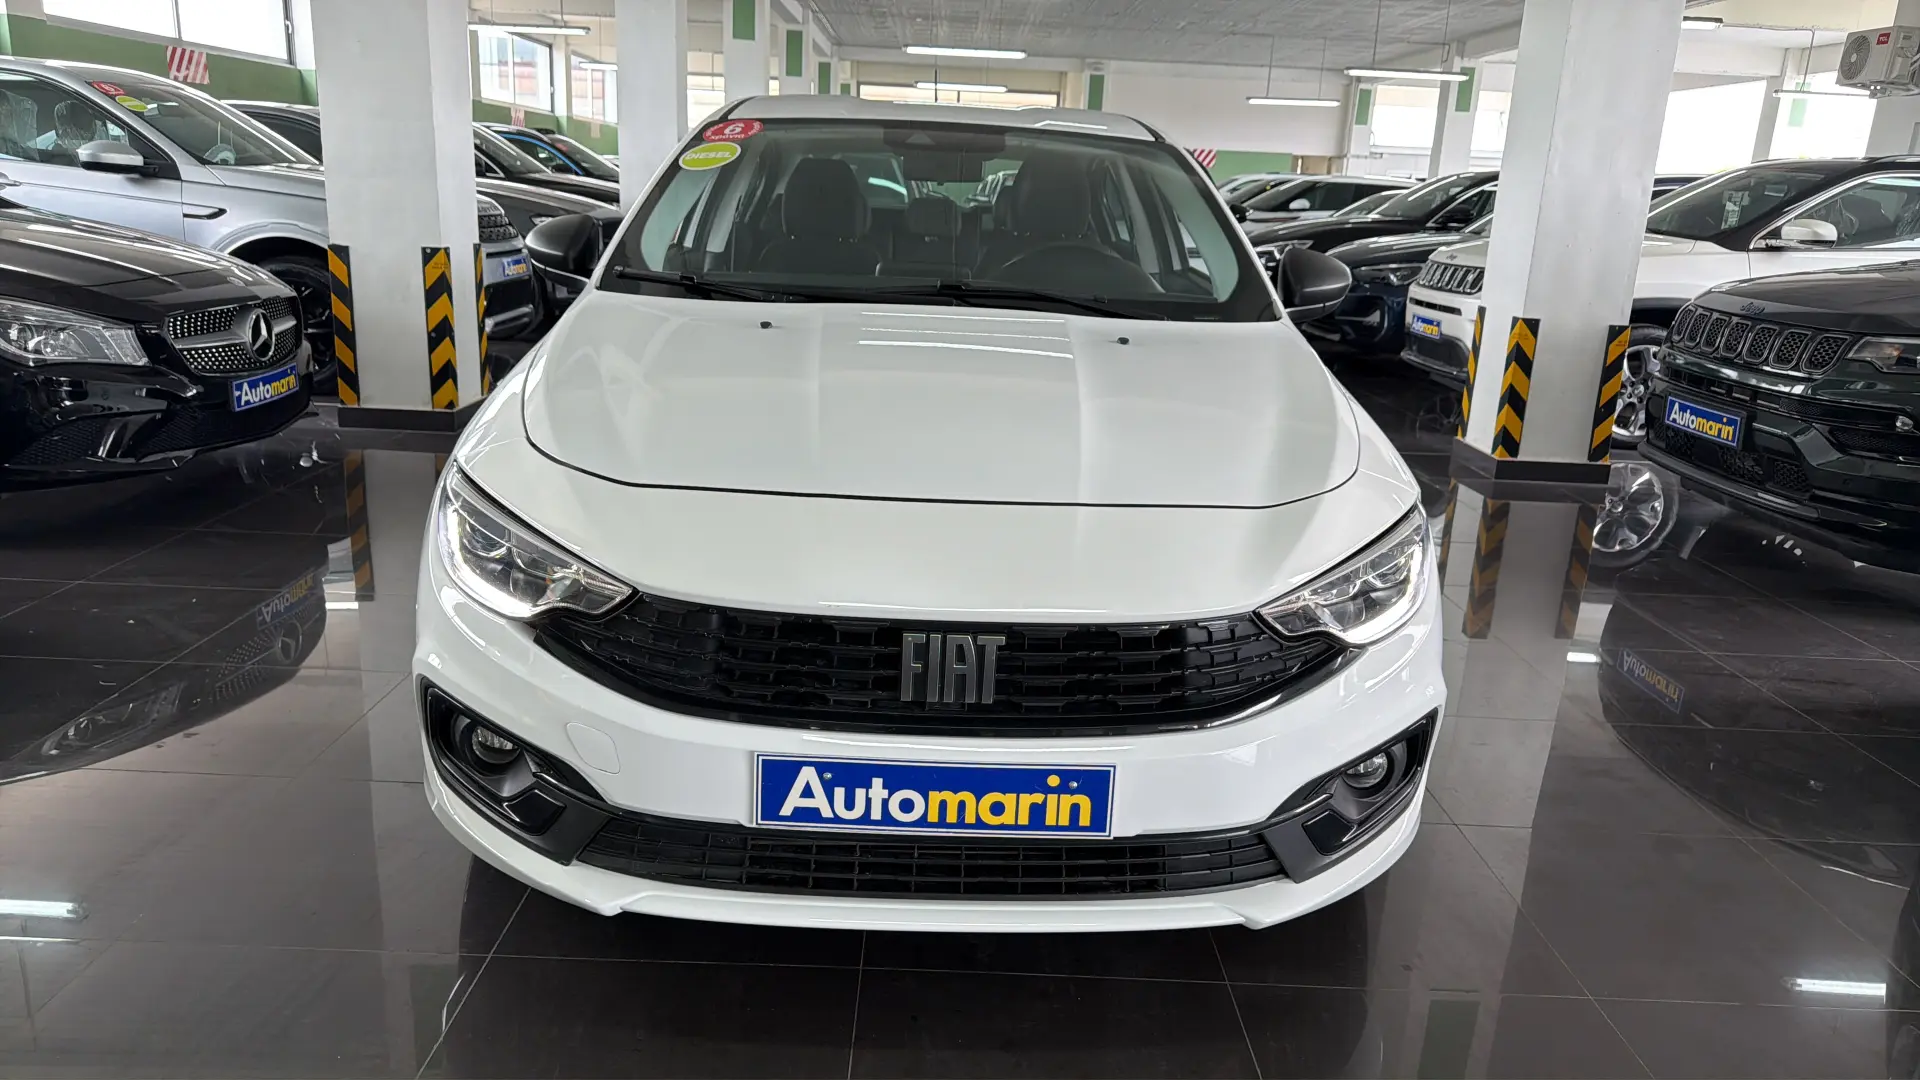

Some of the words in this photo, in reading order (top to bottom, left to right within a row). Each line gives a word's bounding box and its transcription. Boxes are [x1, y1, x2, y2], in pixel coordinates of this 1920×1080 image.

[723, 122, 745, 135] 6
[684, 150, 732, 160] DIESEL
[1740, 301, 1766, 316] Jeep
[241, 368, 297, 407] Automarin
[1669, 401, 1735, 441] Automarin
[900, 633, 1006, 704] FIAT
[778, 765, 1093, 827] Automarin
